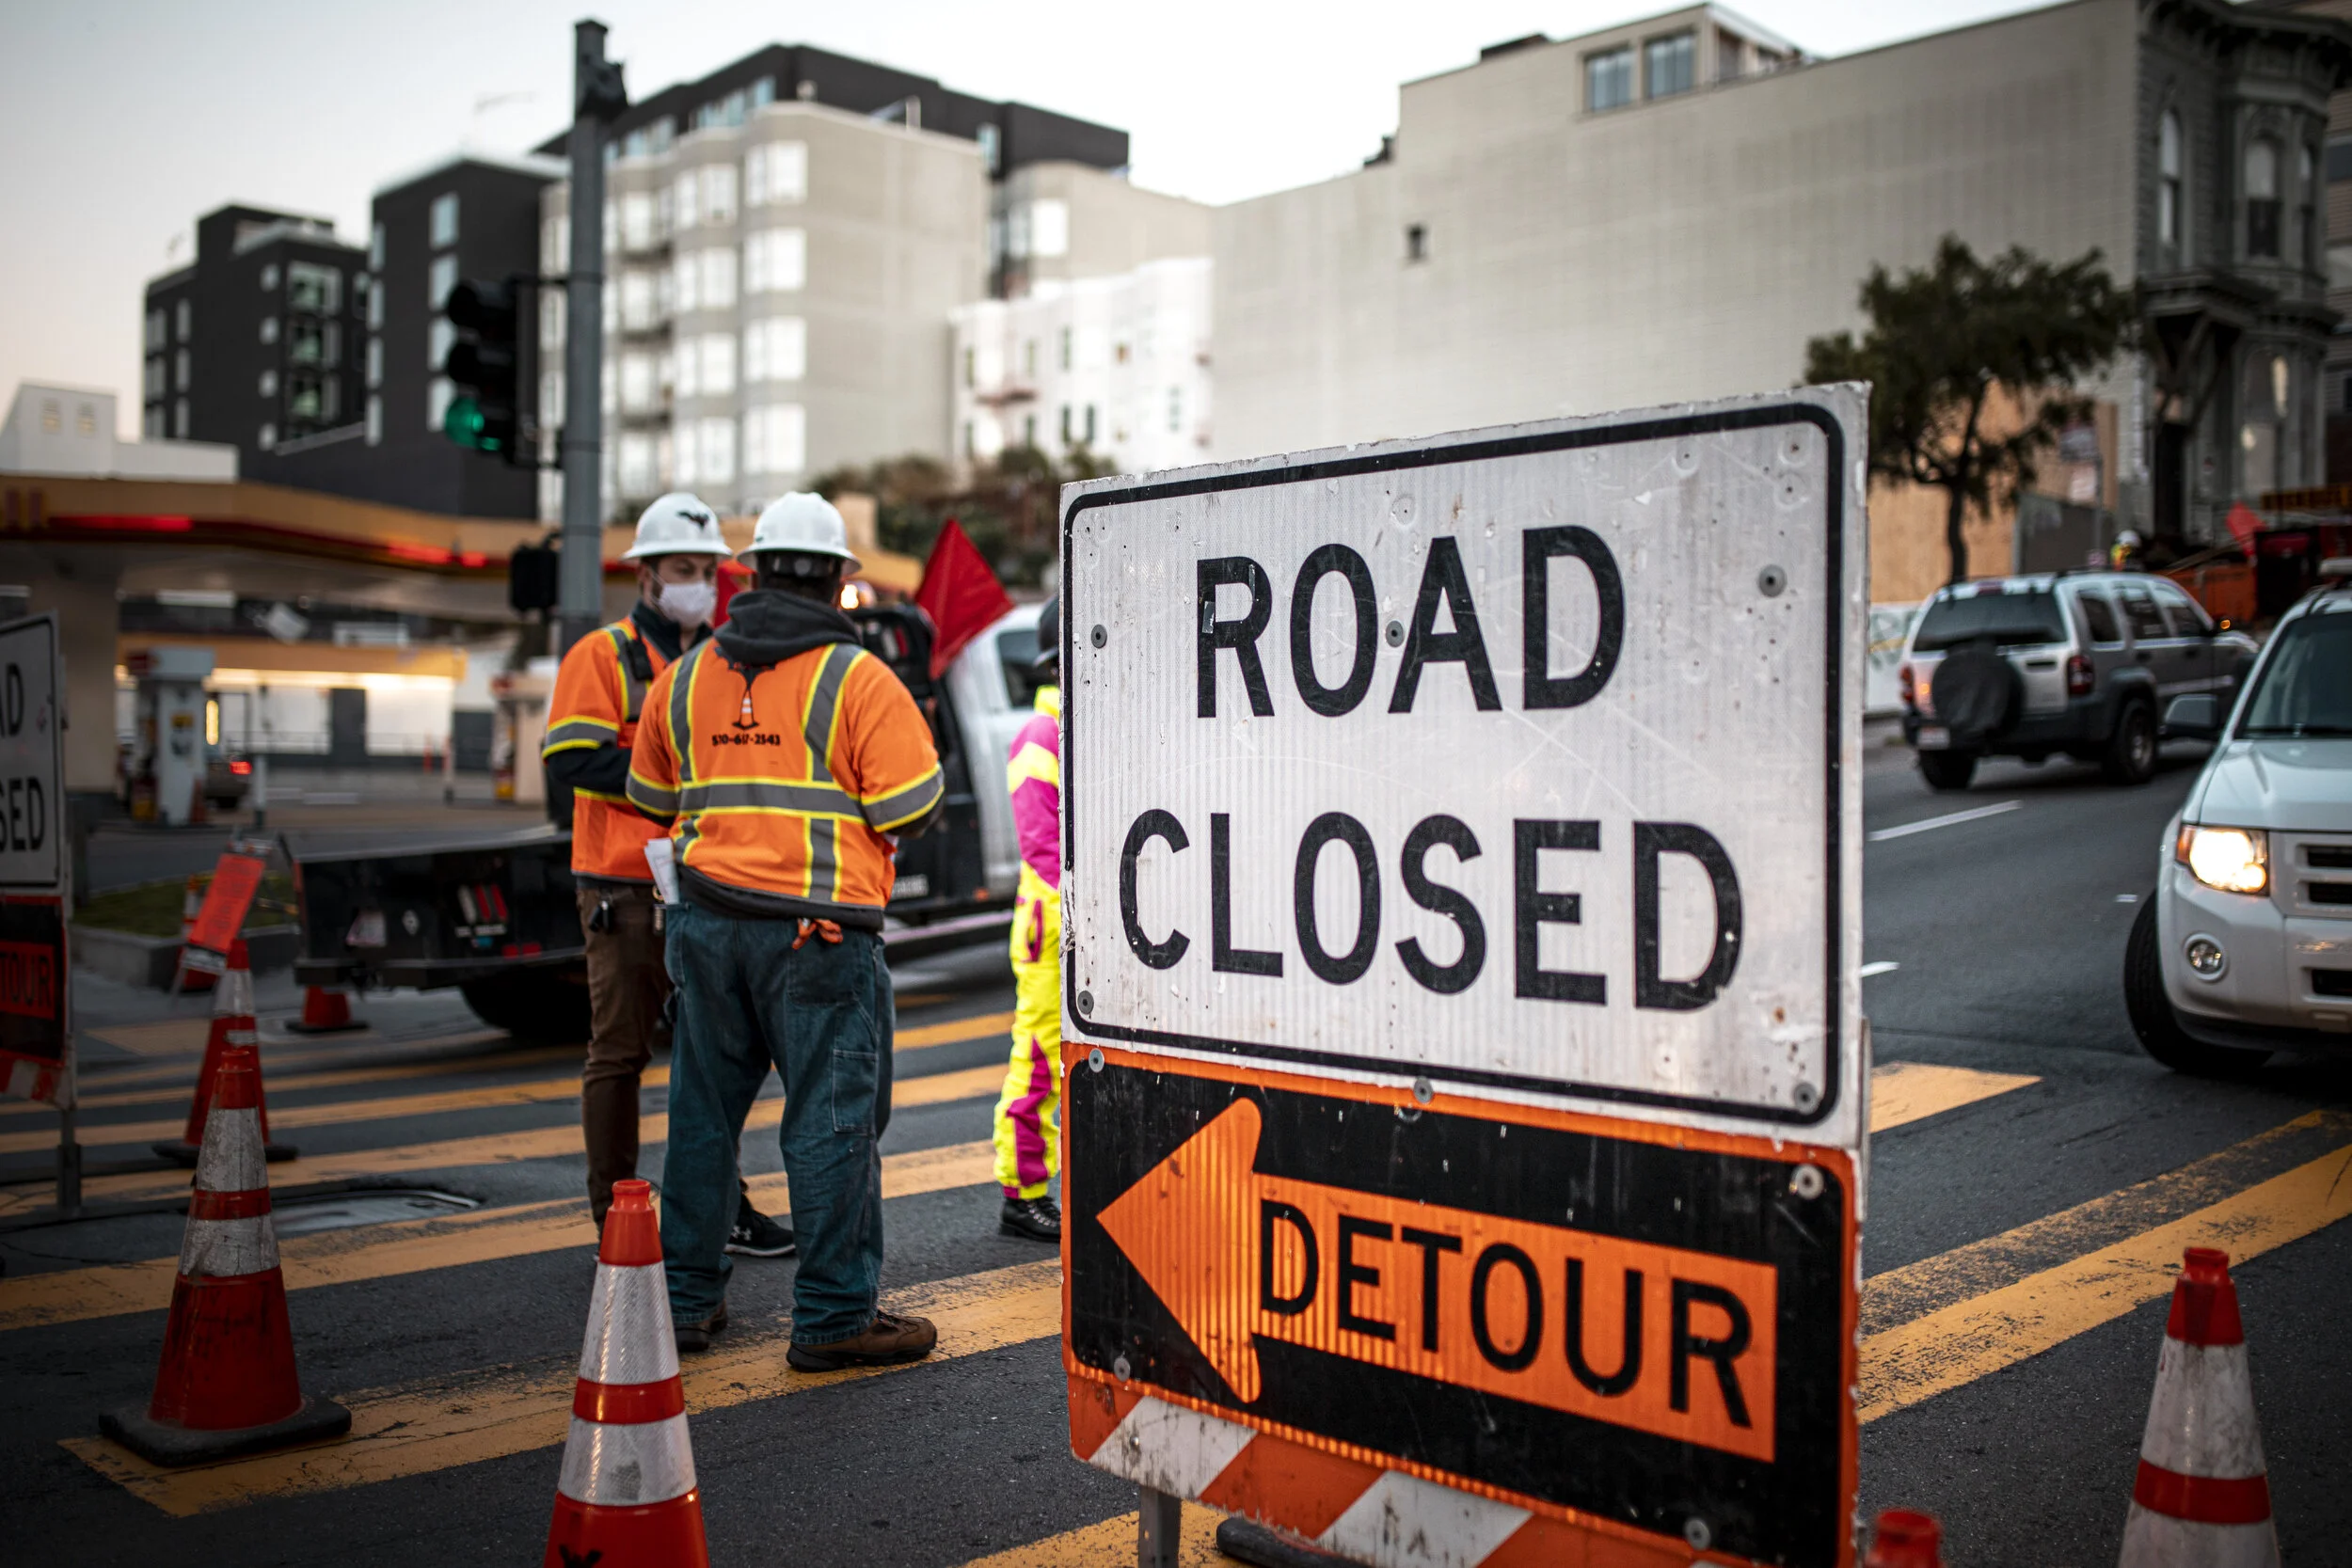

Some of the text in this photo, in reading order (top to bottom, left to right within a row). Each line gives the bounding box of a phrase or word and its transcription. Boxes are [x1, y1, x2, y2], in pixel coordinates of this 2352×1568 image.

[1197, 525, 1625, 719] ROAD
[1120, 809, 1743, 1011] CLOSED
[1260, 1198, 1753, 1430] DETOUR
